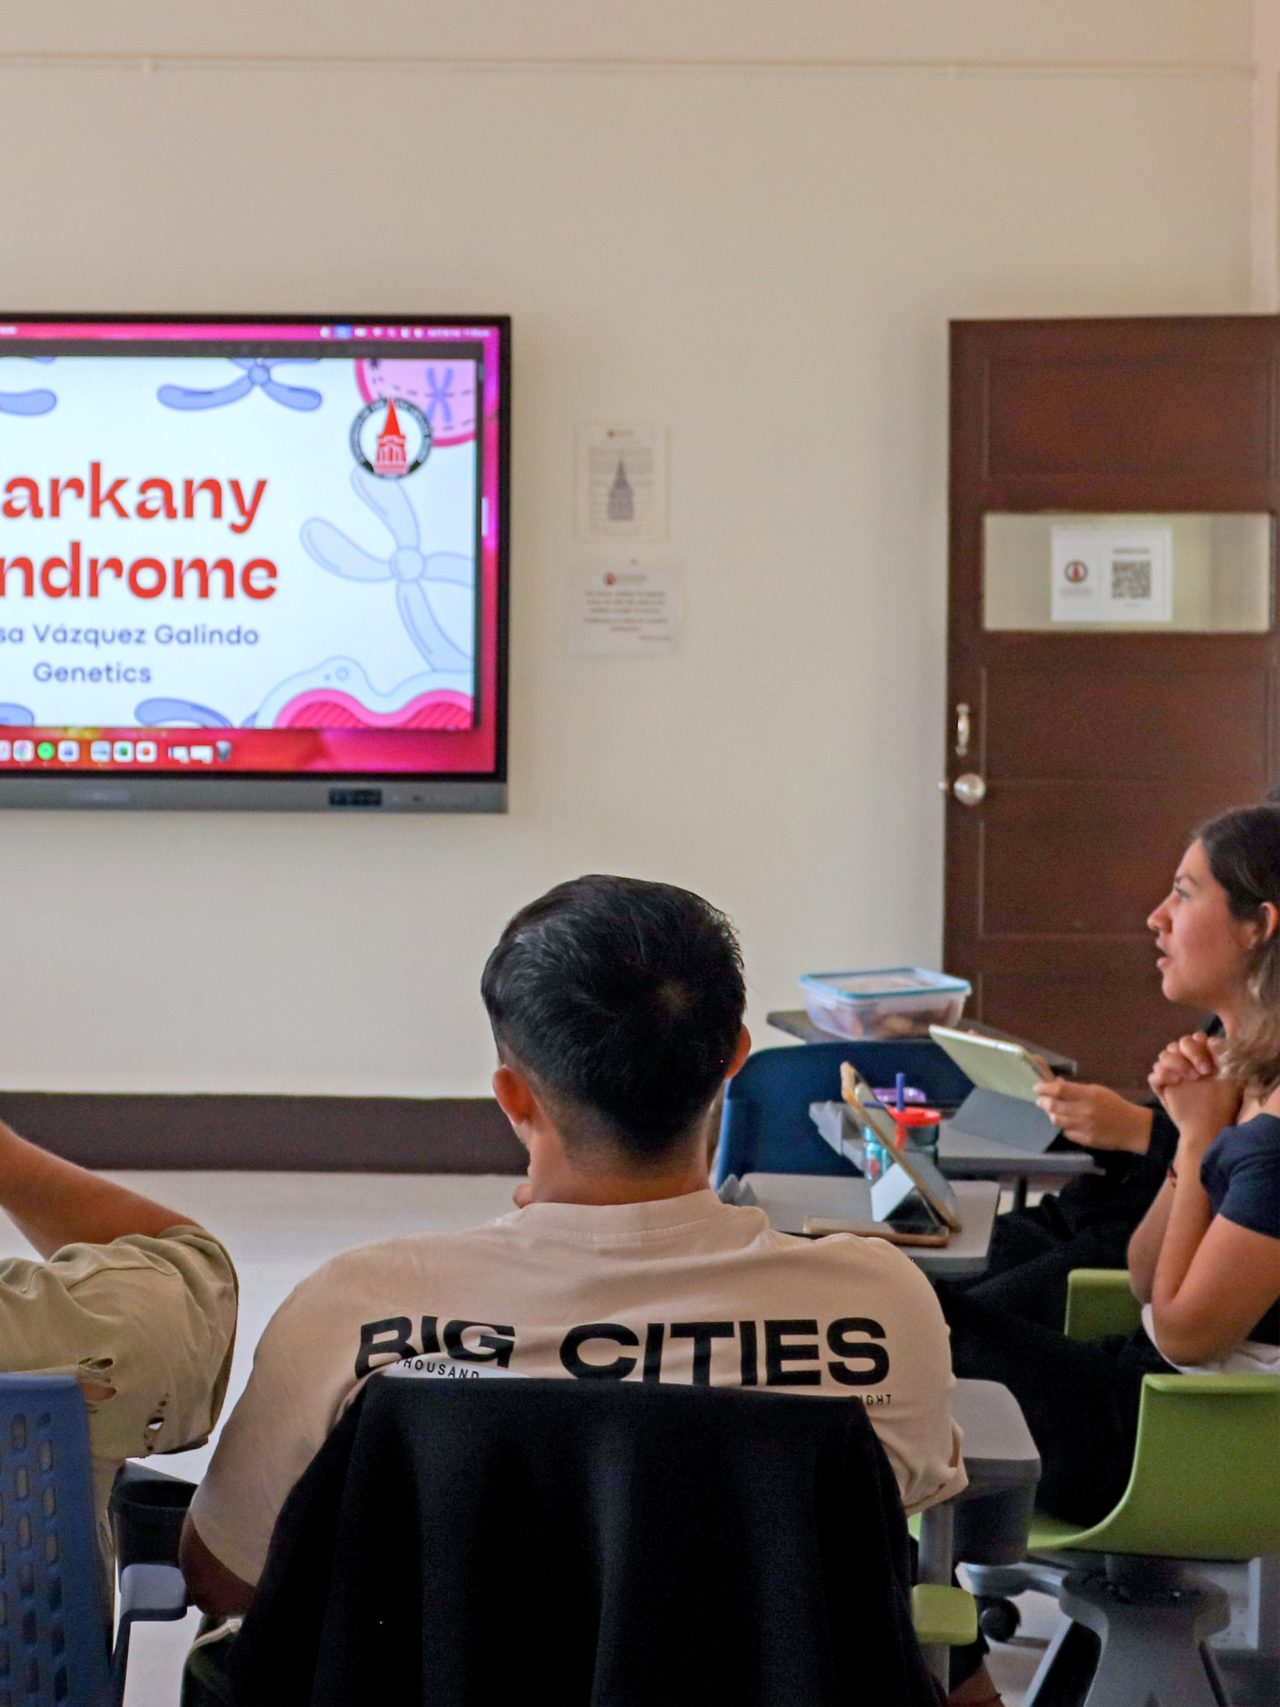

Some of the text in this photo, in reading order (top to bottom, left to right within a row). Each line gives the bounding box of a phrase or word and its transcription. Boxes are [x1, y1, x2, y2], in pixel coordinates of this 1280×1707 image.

[32, 621, 146, 649] Vázquez
[154, 622, 260, 646] Galindo
[32, 661, 153, 685] Genetics
[355, 1315, 890, 1386] BIG CITIES
[396, 1357, 480, 1379] HOUSAND
